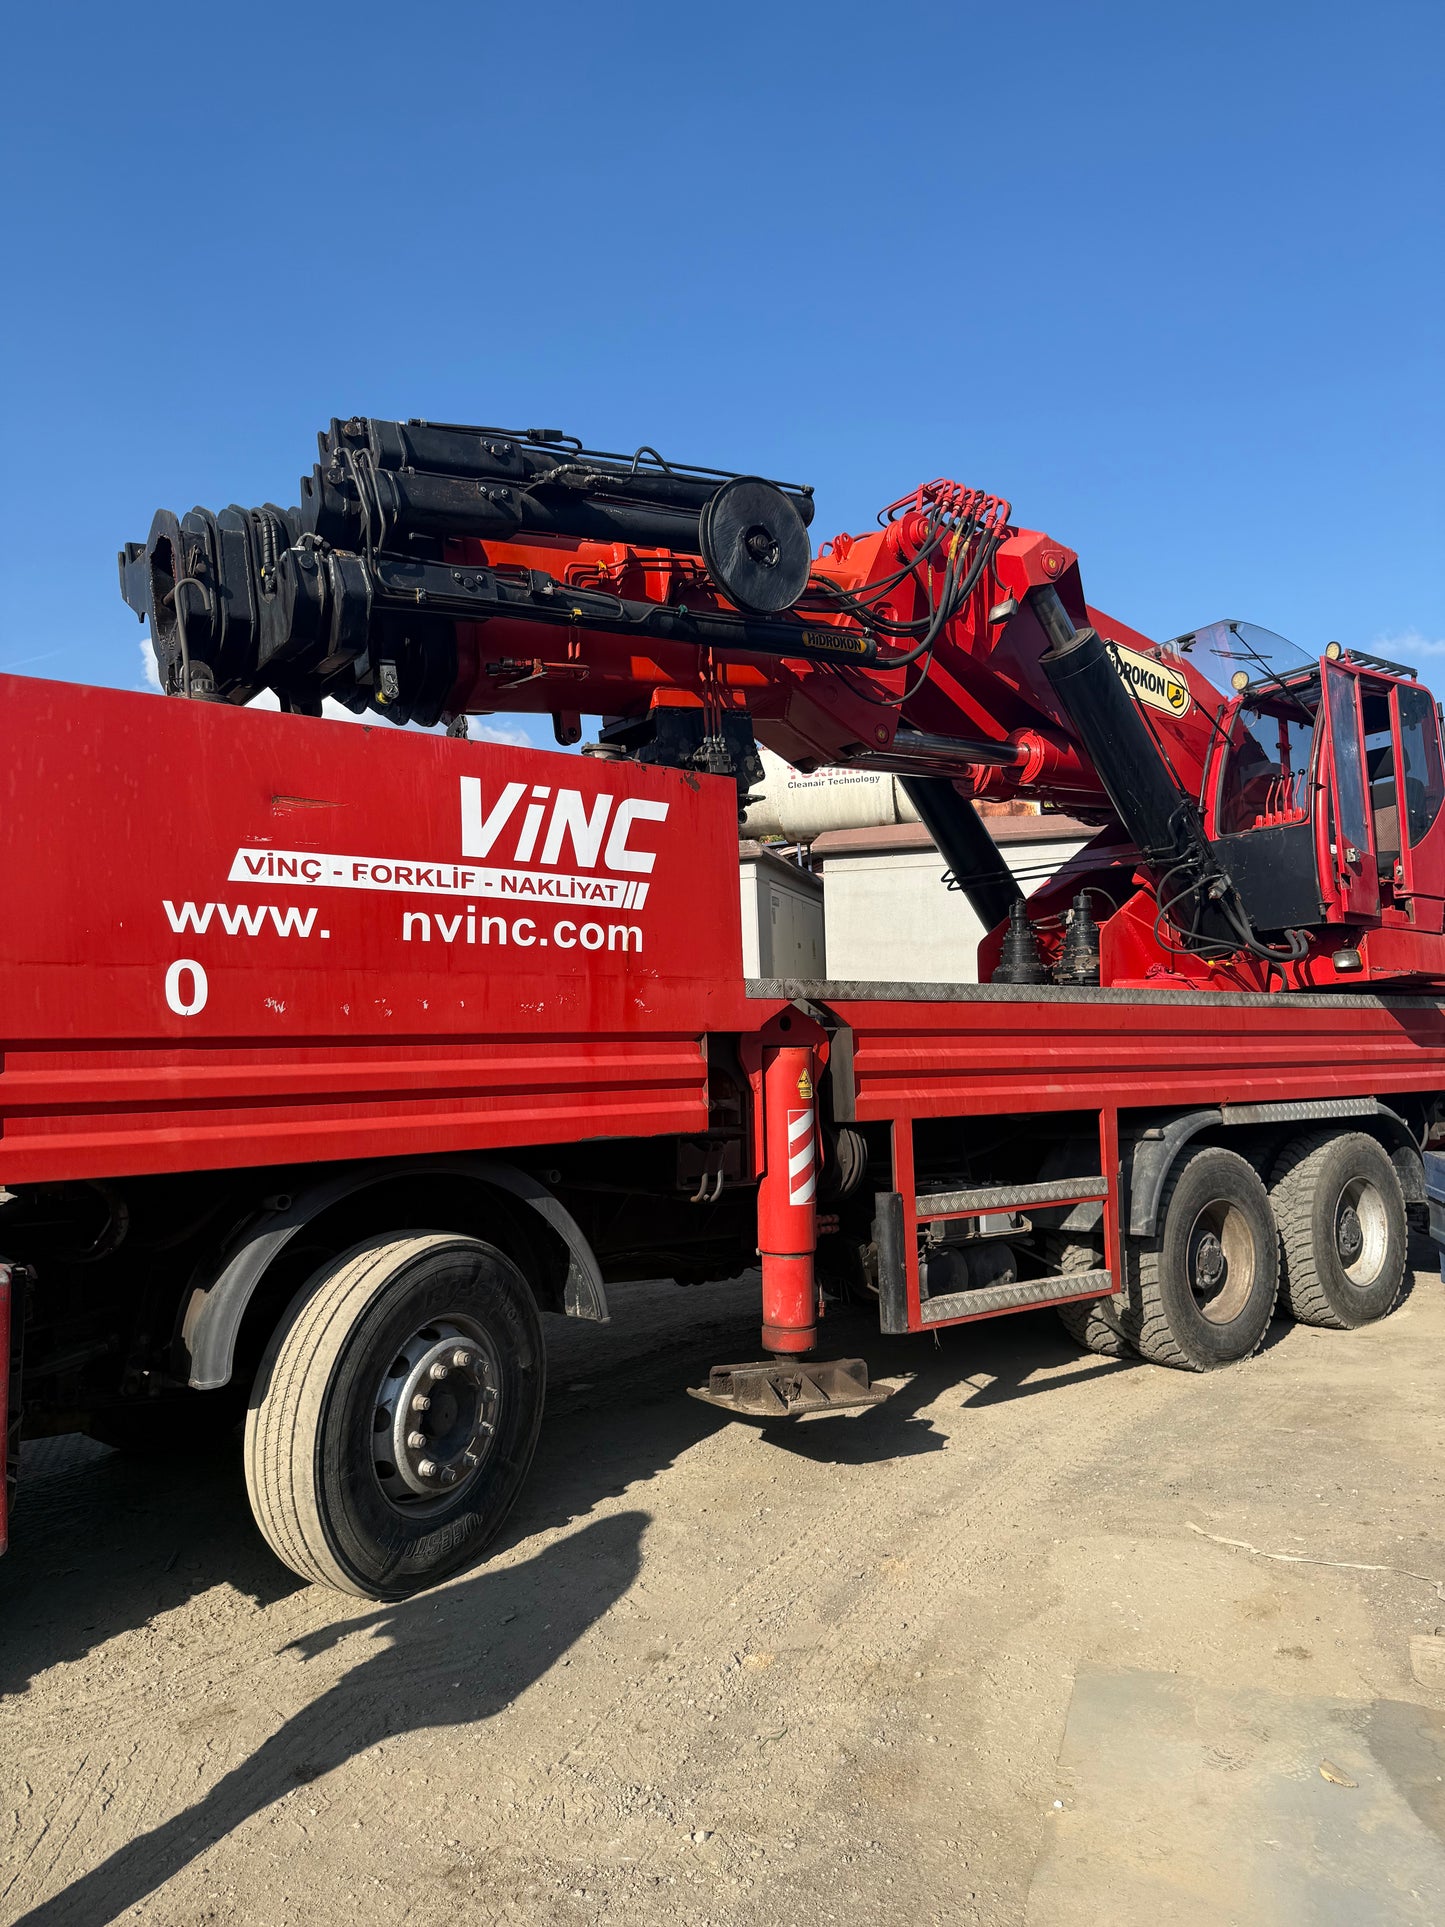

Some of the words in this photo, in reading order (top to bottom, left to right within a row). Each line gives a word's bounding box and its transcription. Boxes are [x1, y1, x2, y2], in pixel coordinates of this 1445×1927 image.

[787, 779, 825, 789] Cleanair
[828, 775, 881, 786] Technology
[243, 852, 323, 883] VİNÇ
[352, 862, 476, 889] FORKLİF
[500, 874, 619, 902] NAKLİYAT
[162, 900, 331, 939] www.
[403, 904, 643, 953] nvinc.com
[165, 958, 209, 1016] 0
